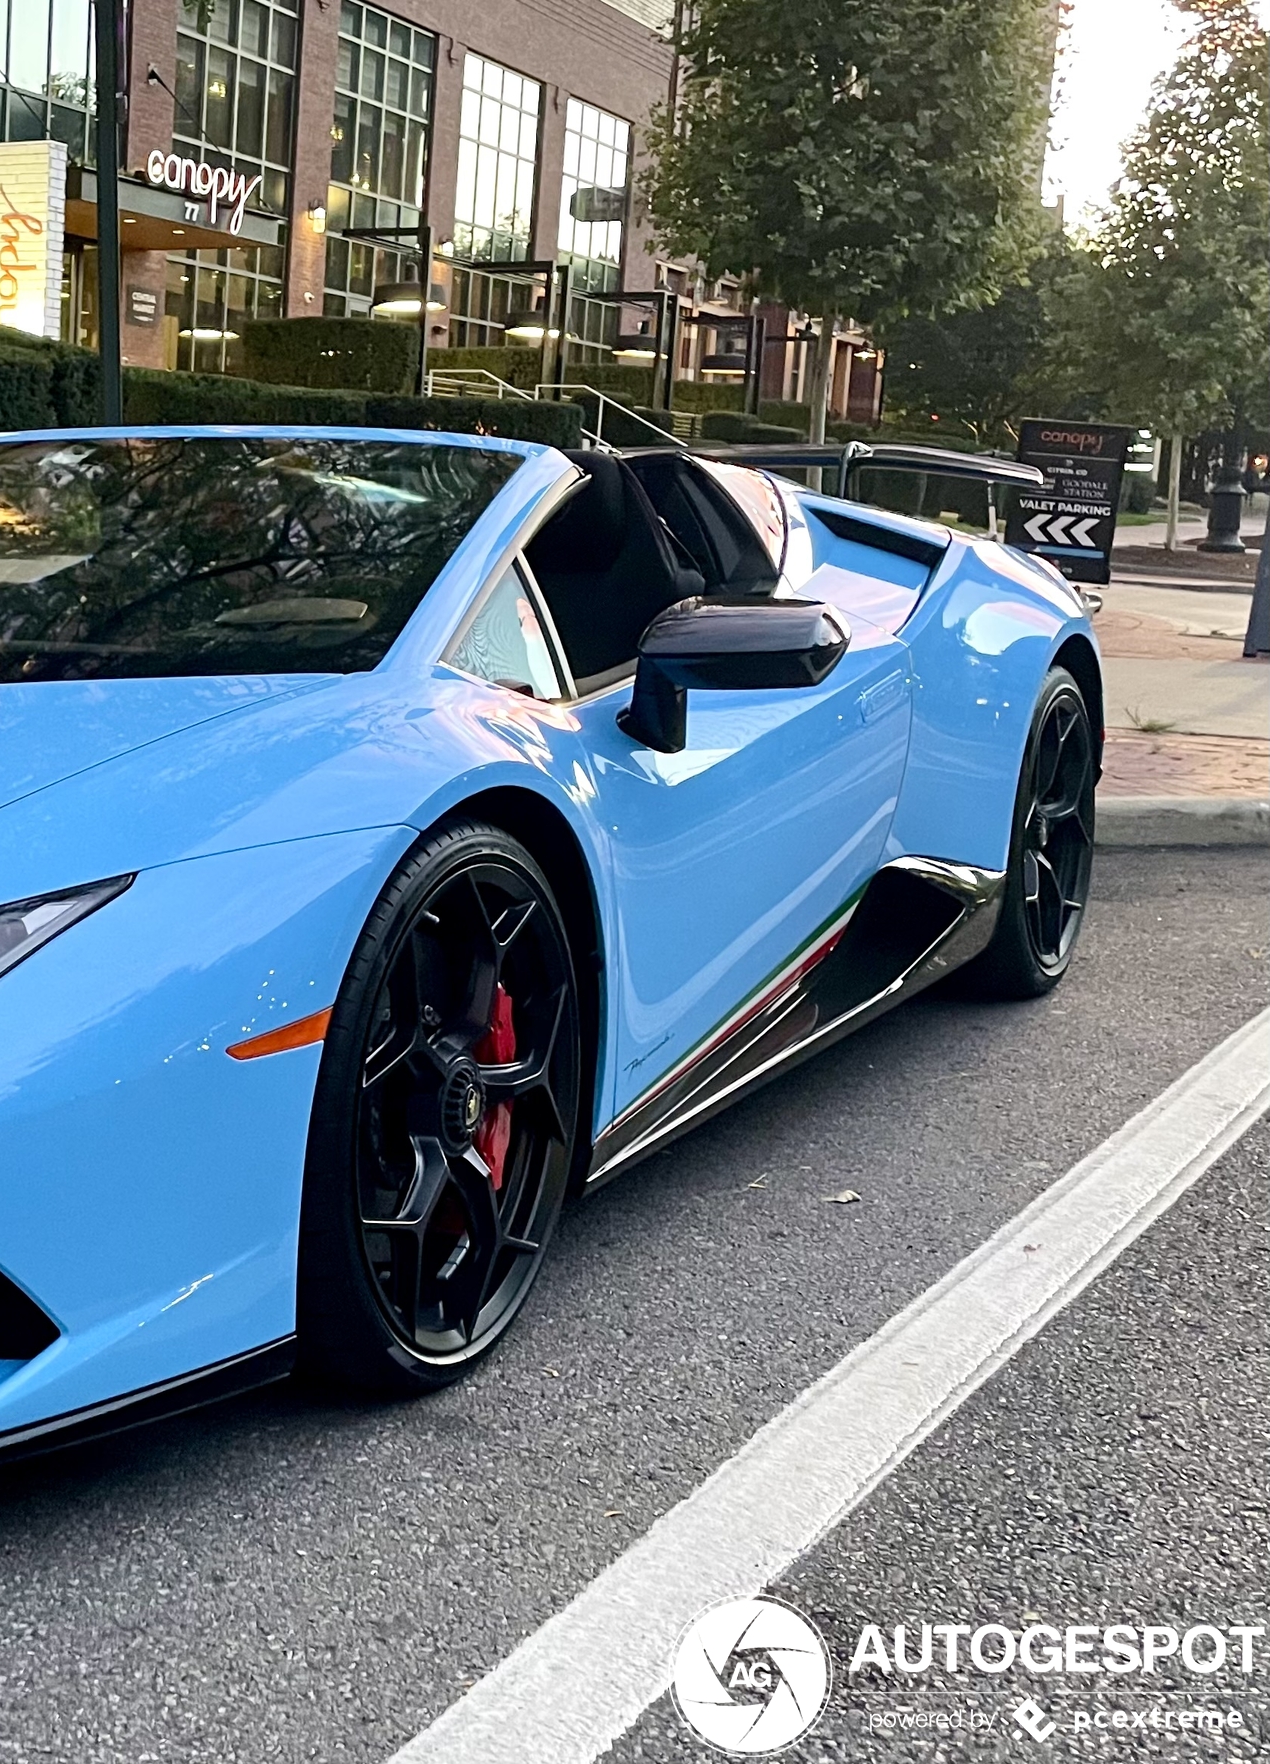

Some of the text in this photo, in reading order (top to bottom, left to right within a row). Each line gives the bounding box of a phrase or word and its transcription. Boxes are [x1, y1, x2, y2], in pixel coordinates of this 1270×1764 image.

[147, 149, 263, 235] canopy
[184, 201, 200, 222] 77
[1040, 430, 1104, 454] canopy
[1061, 479, 1109, 491] GOODALE
[1062, 488, 1105, 499] STATION
[1019, 499, 1112, 516] VALET PARKING
